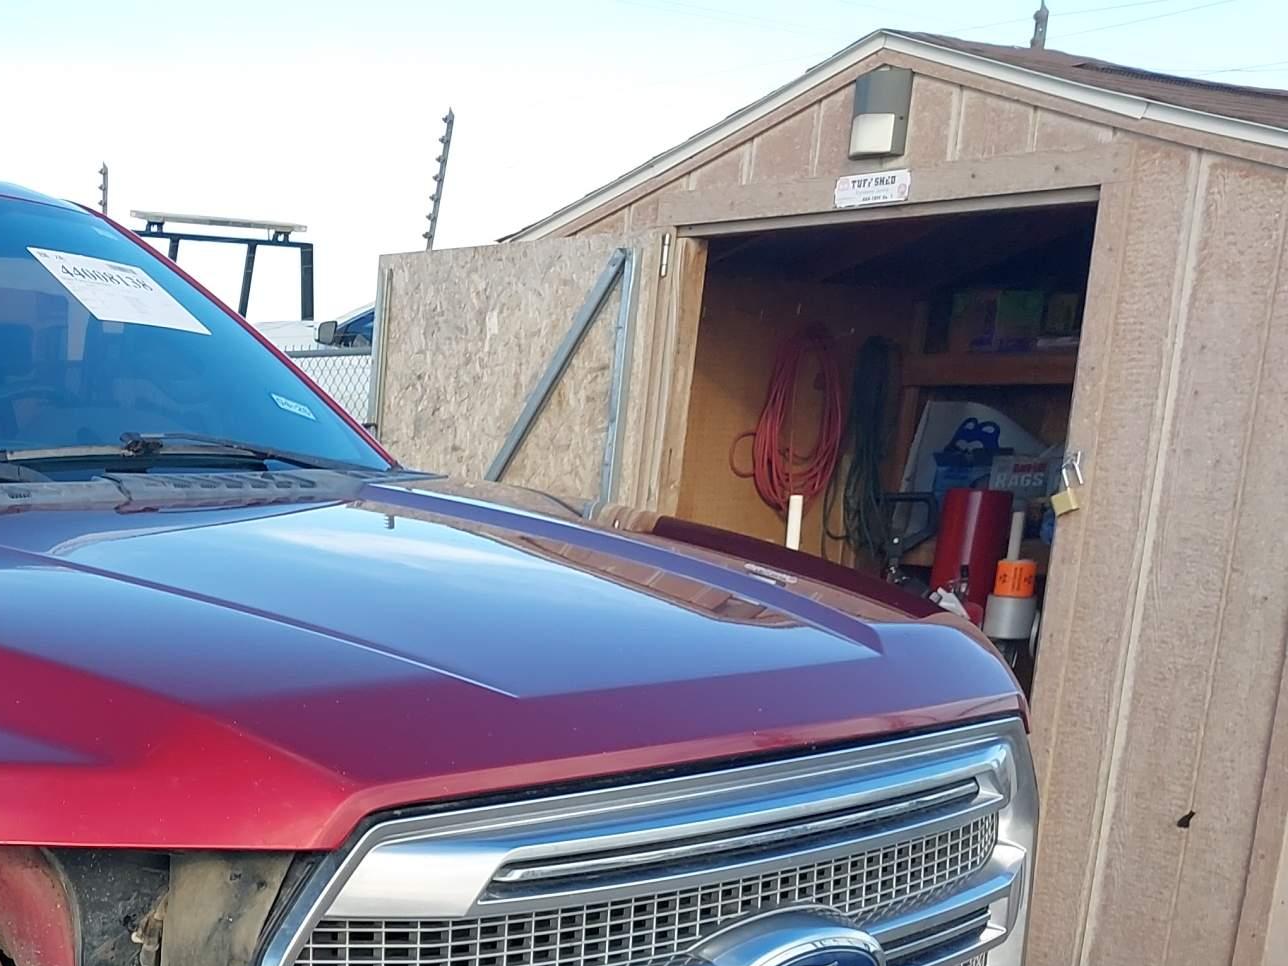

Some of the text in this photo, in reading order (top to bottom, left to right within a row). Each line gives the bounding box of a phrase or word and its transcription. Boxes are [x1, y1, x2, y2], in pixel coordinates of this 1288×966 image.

[875, 175, 896, 187] SHED
[61, 263, 153, 291] 44008138
[996, 473, 1044, 487] RAGS
